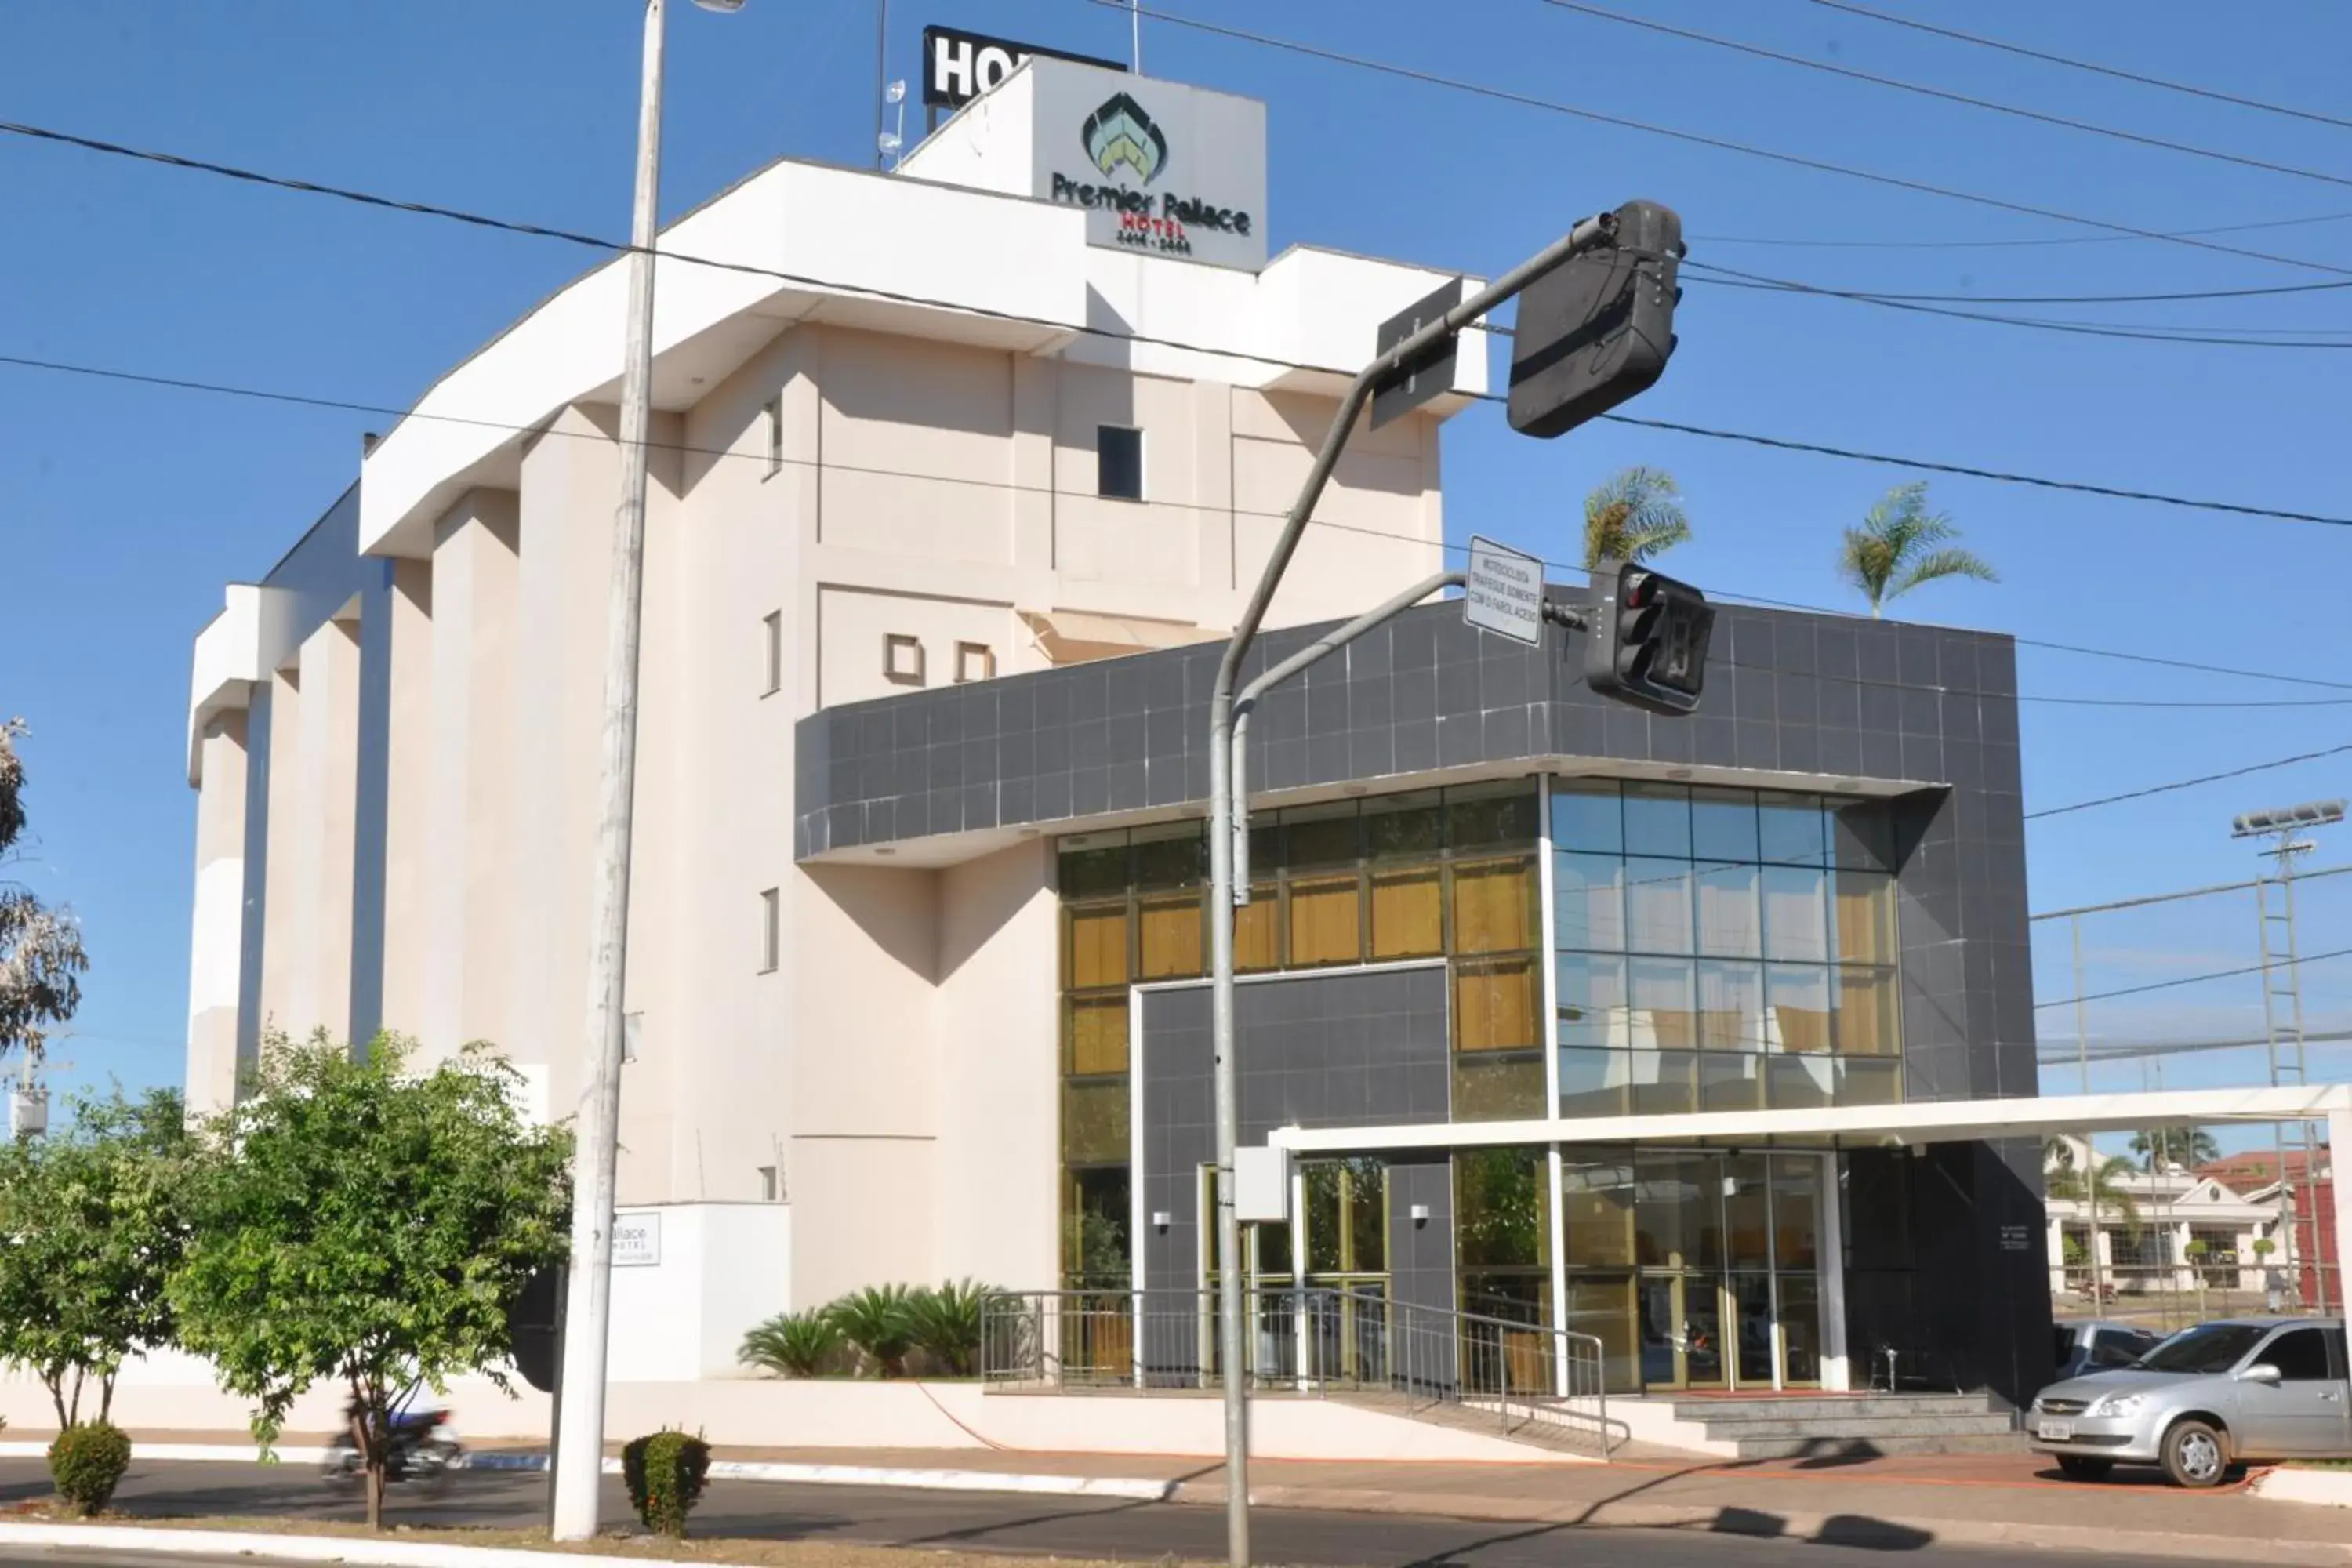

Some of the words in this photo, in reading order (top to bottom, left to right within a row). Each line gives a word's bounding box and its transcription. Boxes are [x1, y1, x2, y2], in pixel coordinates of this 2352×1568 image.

[935, 37, 1033, 96] HO
[1052, 172, 1155, 213] Premier
[1163, 192, 1250, 236] Pallace
[1121, 212, 1186, 240] HOTEL
[1507, 585, 1537, 605] SOMENTE
[612, 1227, 646, 1239] allace
